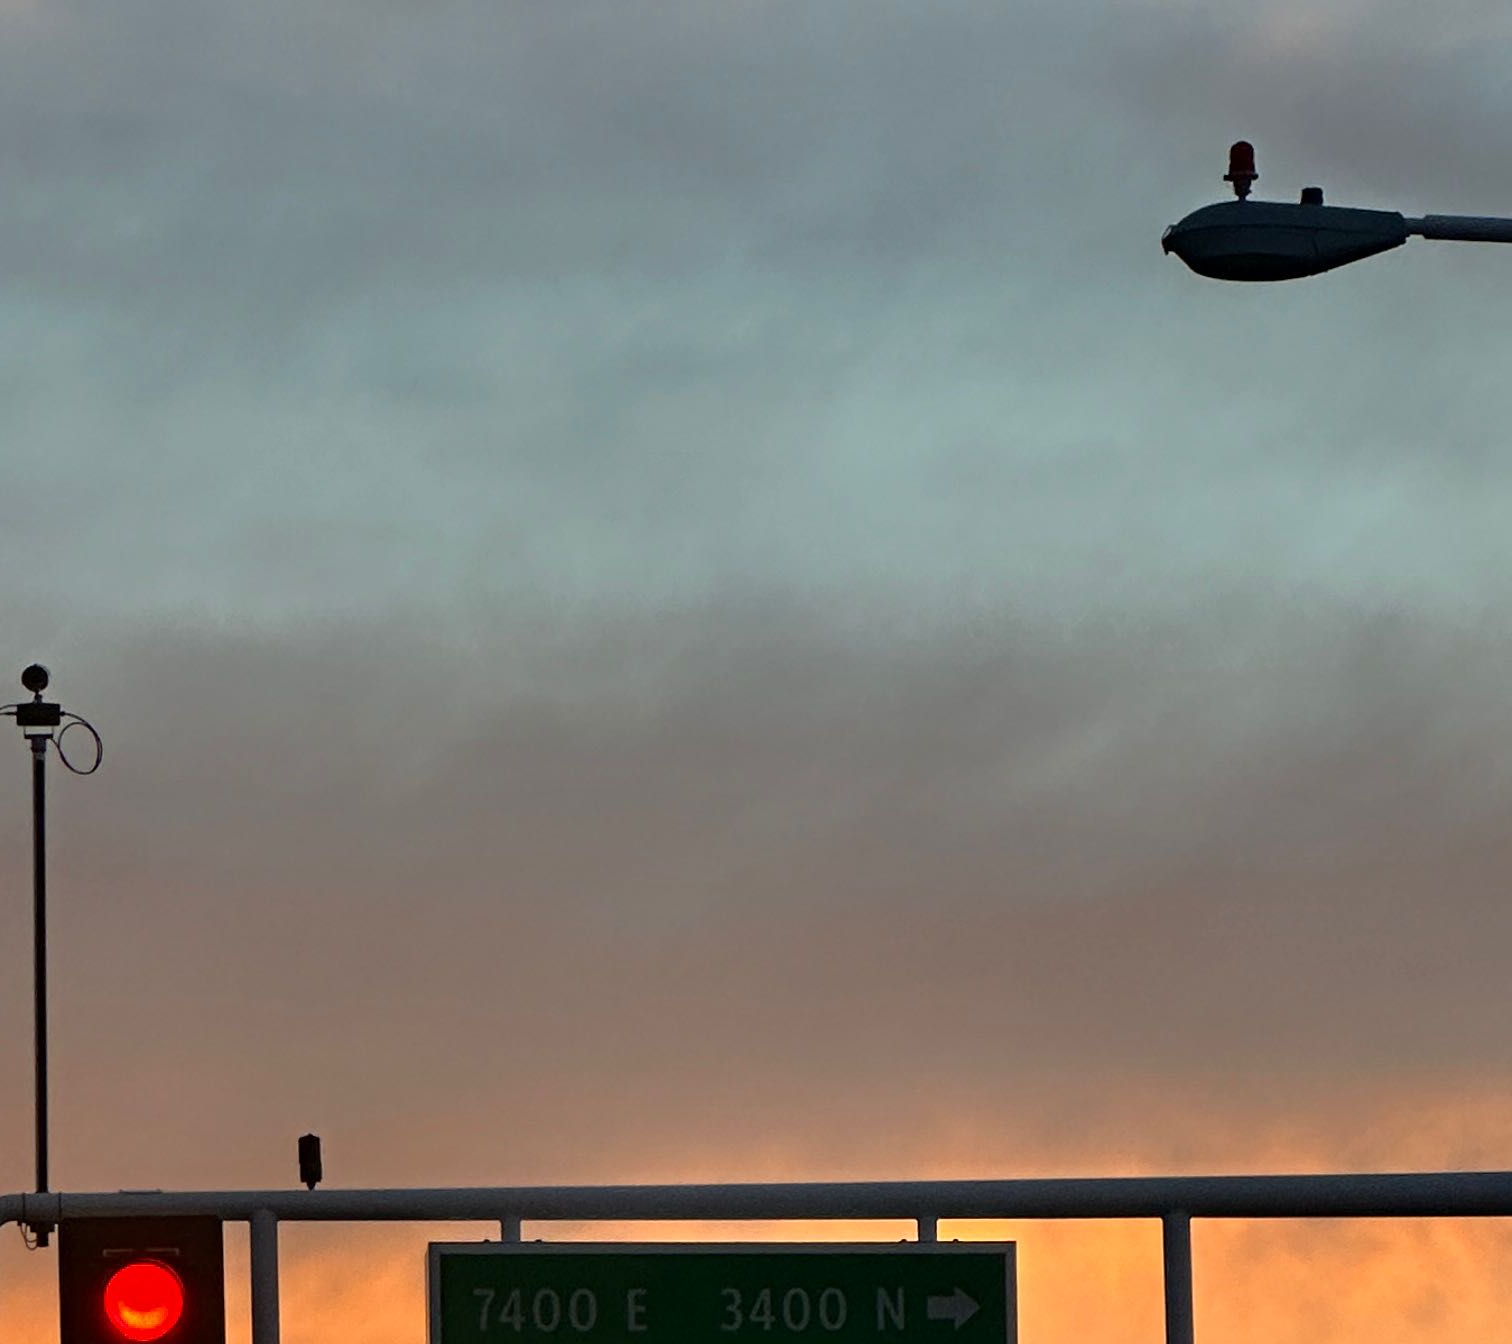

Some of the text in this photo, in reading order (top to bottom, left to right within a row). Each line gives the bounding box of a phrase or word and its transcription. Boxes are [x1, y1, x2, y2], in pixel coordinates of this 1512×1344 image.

[472, 1286, 905, 1332] 7400 E 3400 N
